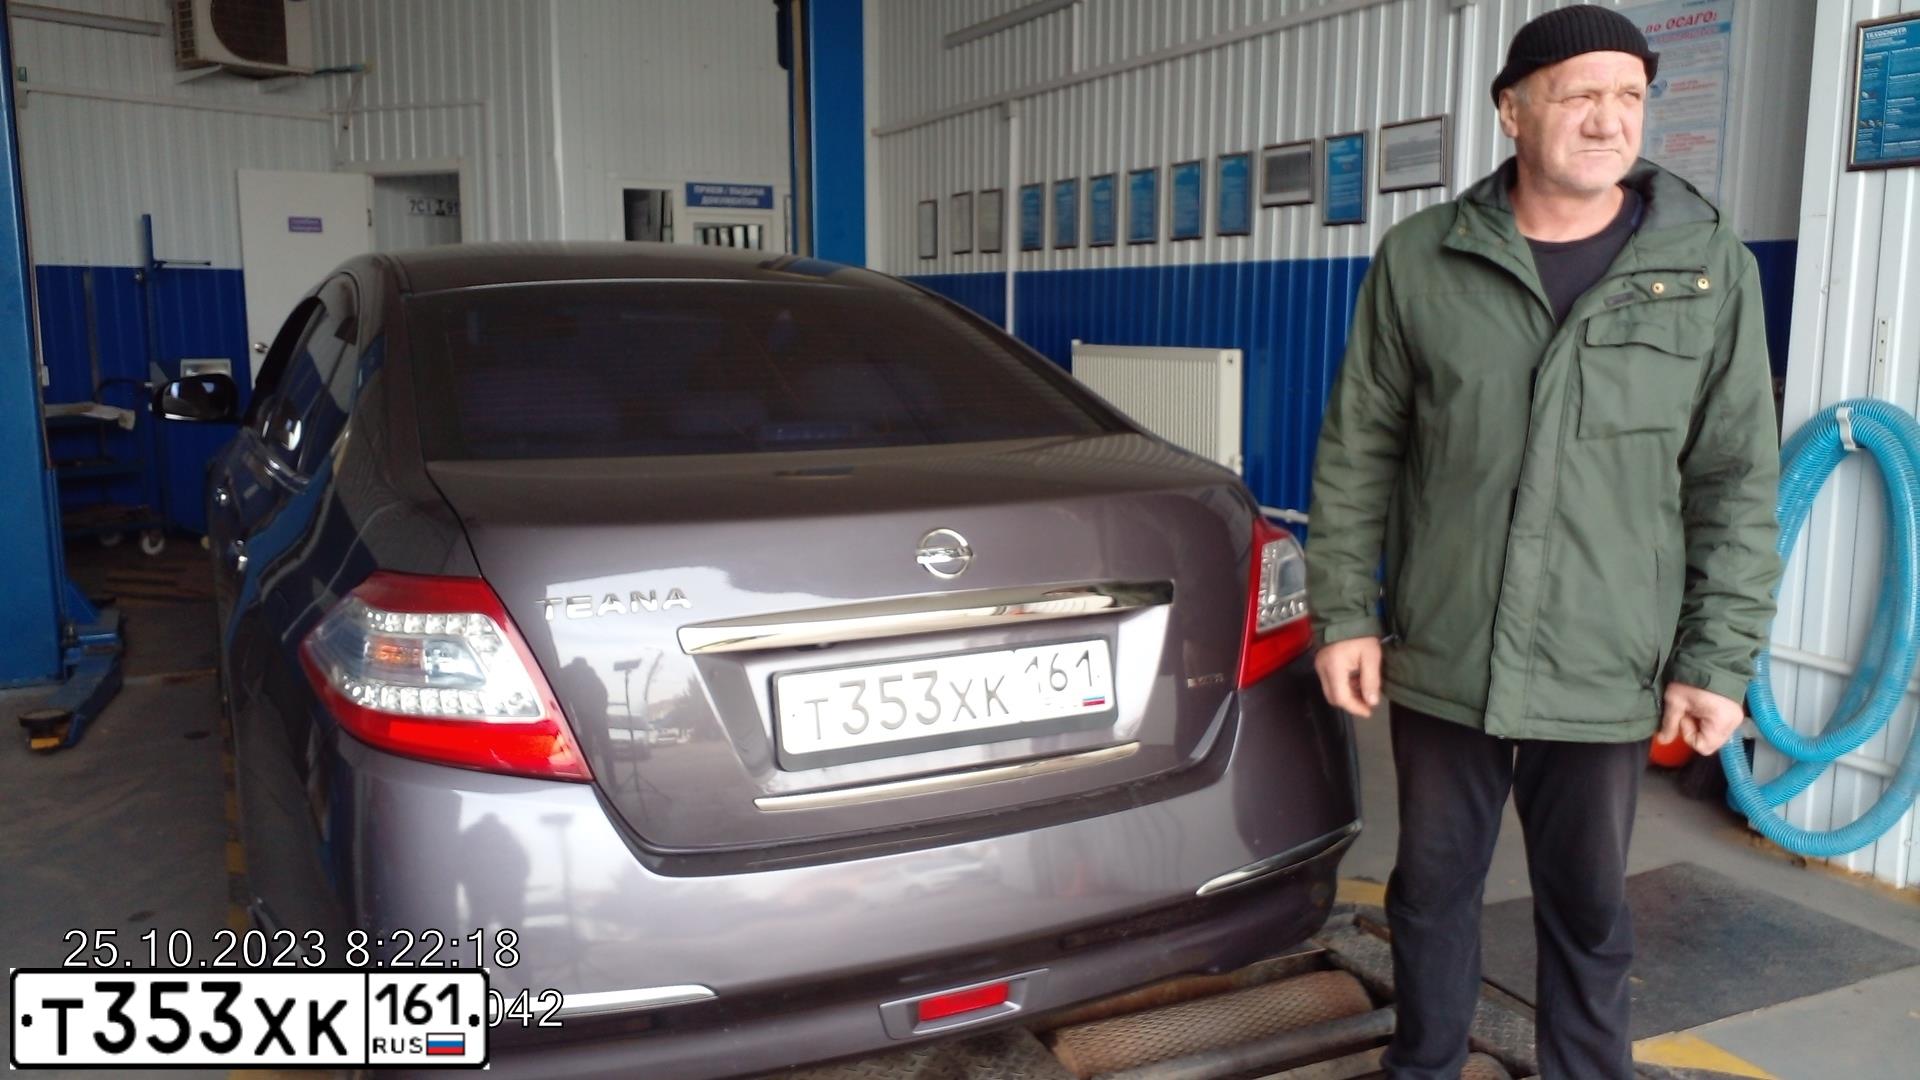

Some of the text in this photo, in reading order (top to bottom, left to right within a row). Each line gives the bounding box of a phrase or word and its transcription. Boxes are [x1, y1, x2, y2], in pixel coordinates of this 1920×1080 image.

[536, 587, 692, 621] TEANA
[803, 650, 1093, 740] Т353ХК 161
